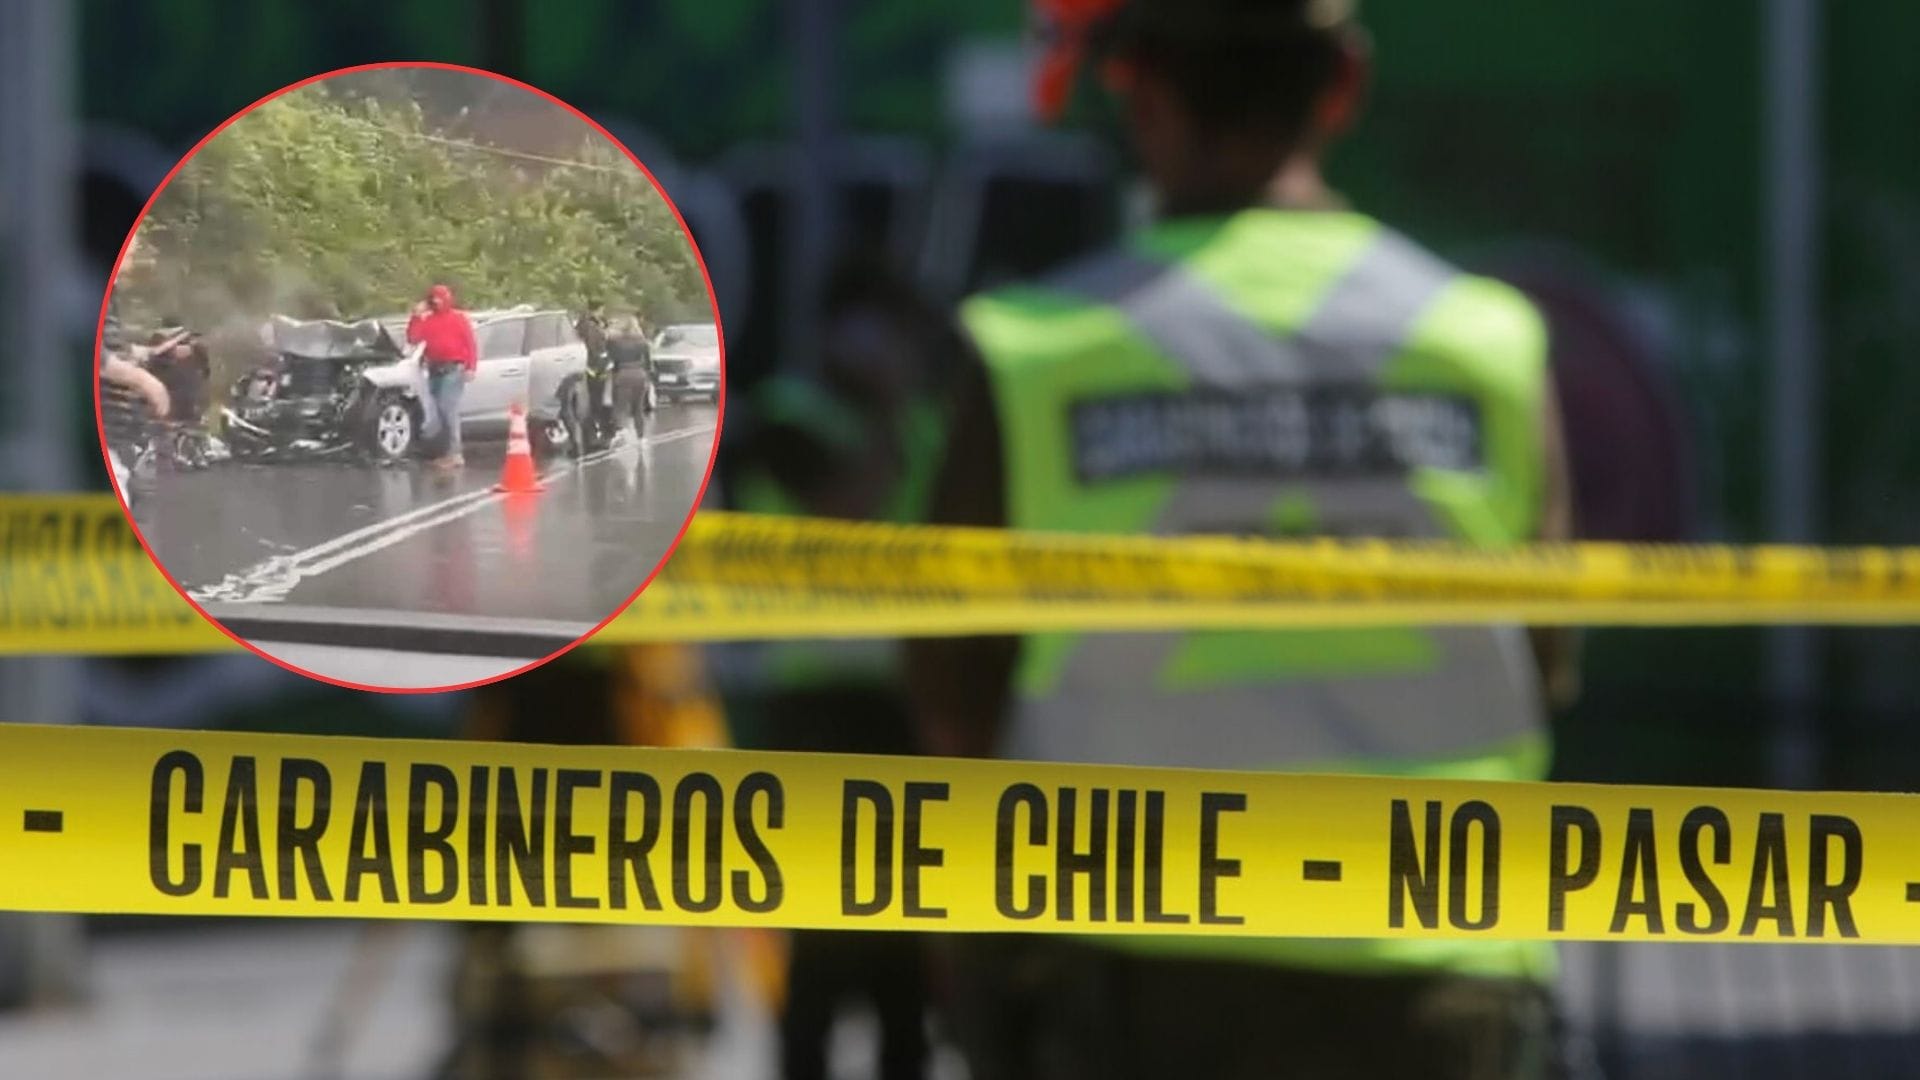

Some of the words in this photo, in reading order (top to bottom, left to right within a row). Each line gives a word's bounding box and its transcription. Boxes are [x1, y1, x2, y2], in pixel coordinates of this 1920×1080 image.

[149, 748, 785, 916] CARABINEROS
[841, 778, 951, 918] DE
[995, 781, 1248, 925] CHILE
[1388, 798, 1502, 931] NO
[1548, 804, 1864, 937] PASAR
